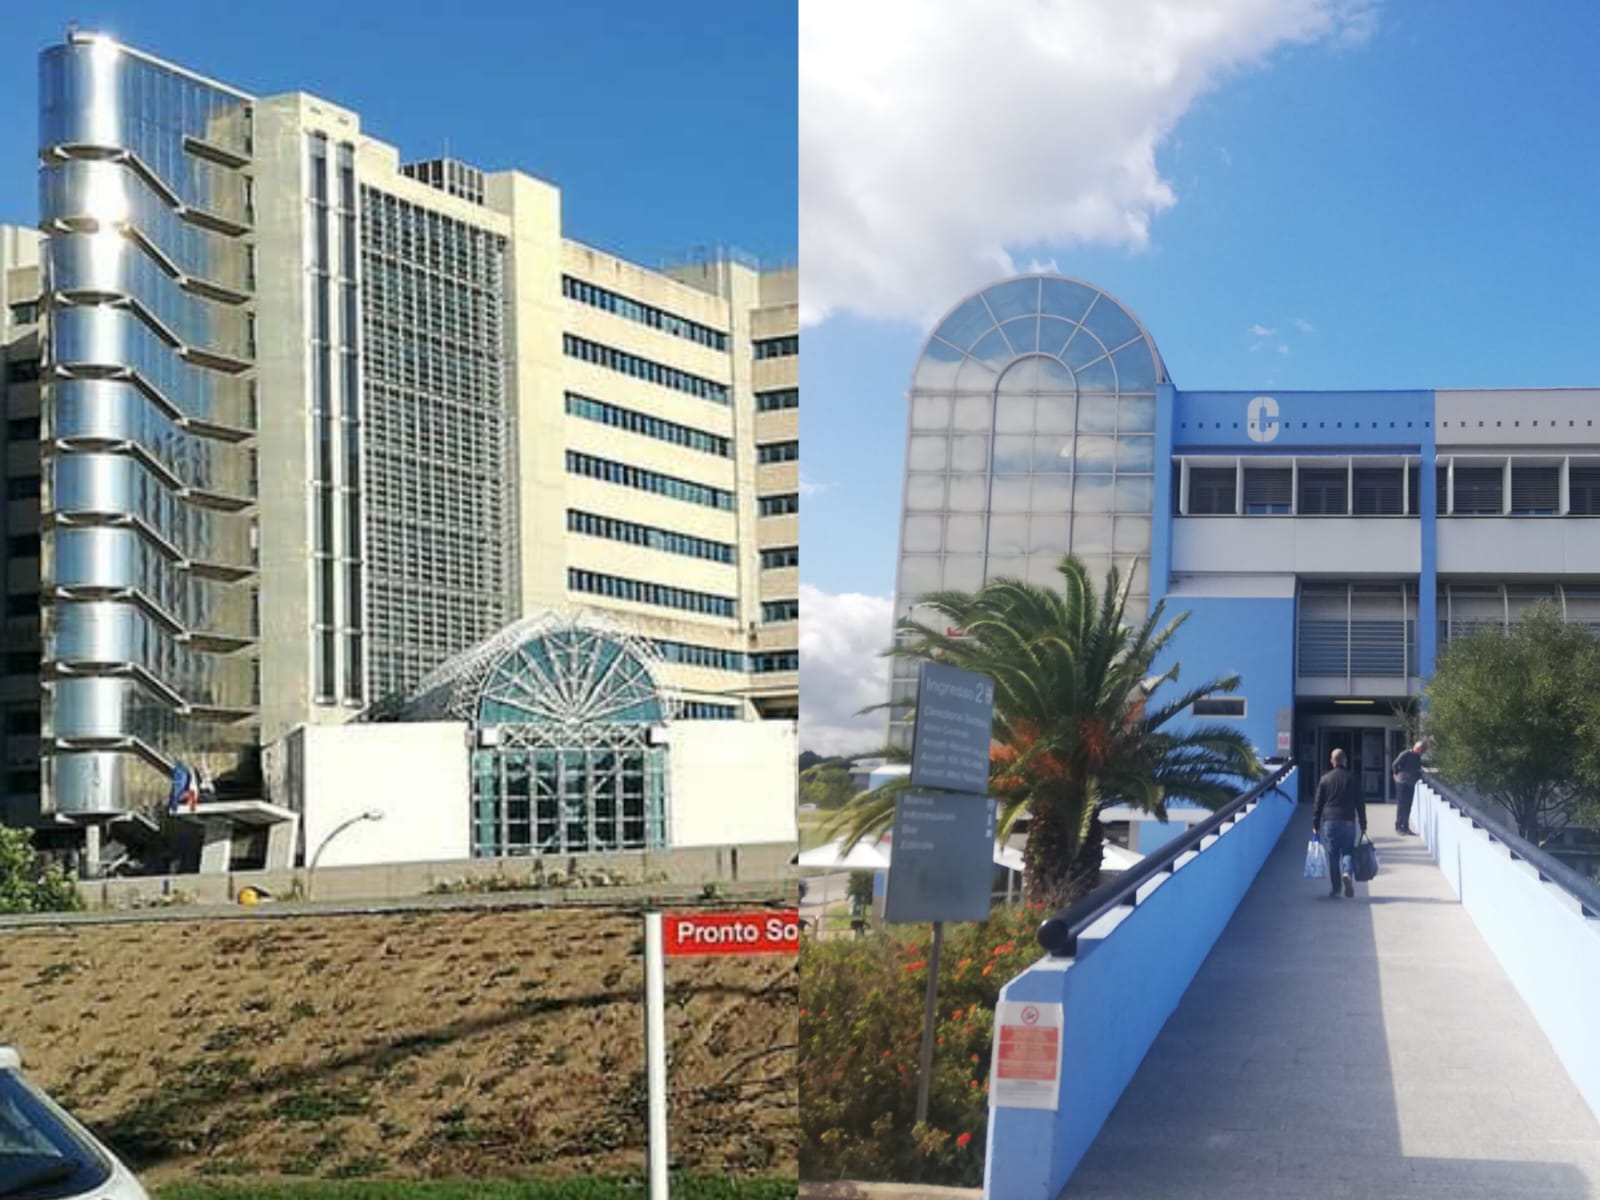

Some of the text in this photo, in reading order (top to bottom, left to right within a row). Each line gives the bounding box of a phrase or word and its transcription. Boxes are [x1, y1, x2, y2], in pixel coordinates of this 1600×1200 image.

[1247, 396, 1280, 442] C
[926, 677, 985, 704] Ingresso 2
[677, 918, 799, 944] Pronto So
